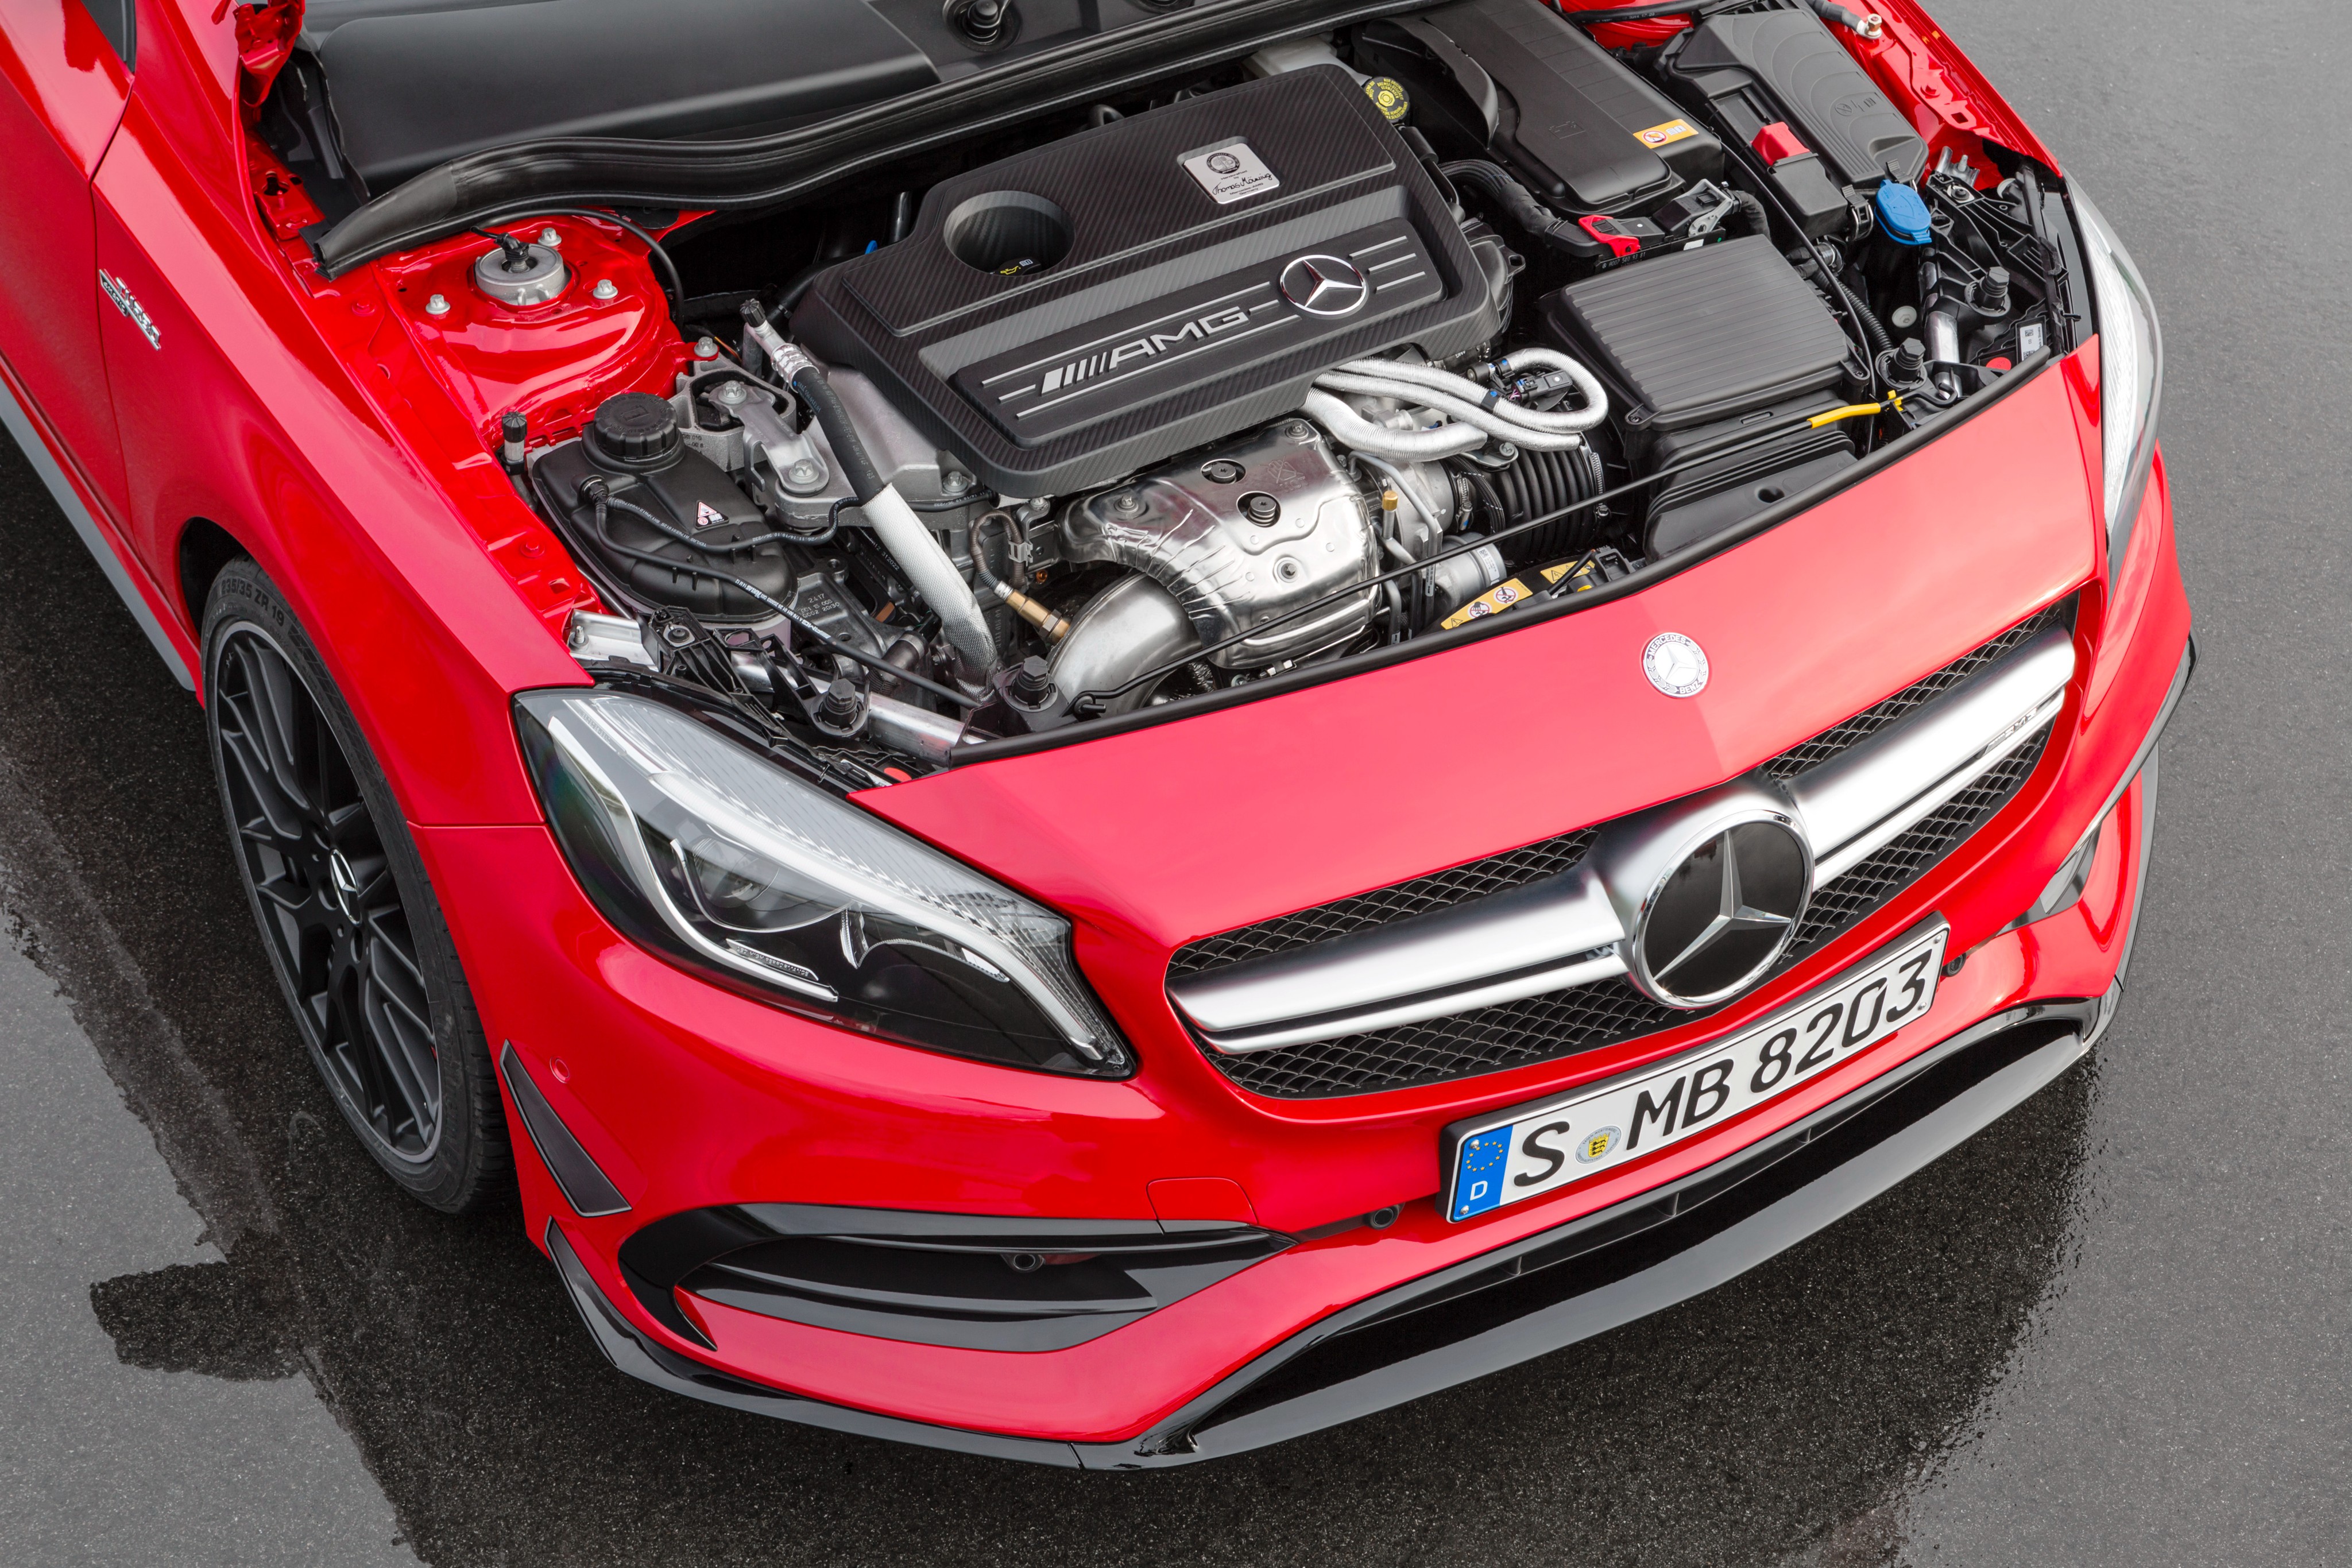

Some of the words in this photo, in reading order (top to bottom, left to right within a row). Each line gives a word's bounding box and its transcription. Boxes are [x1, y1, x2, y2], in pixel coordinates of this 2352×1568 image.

[1212, 181, 1240, 195] Thomas
[1109, 306, 1250, 370] AMG
[221, 578, 253, 599] 235/35
[254, 588, 269, 611] ZR
[272, 605, 284, 627] 19
[1647, 634, 1687, 656] MERCEDES
[1678, 681, 1700, 694] BENZ
[1514, 1121, 1570, 1187] S
[1626, 1058, 1735, 1151] MB
[1750, 948, 1933, 1094] 8203
[1469, 1180, 1488, 1201] D
